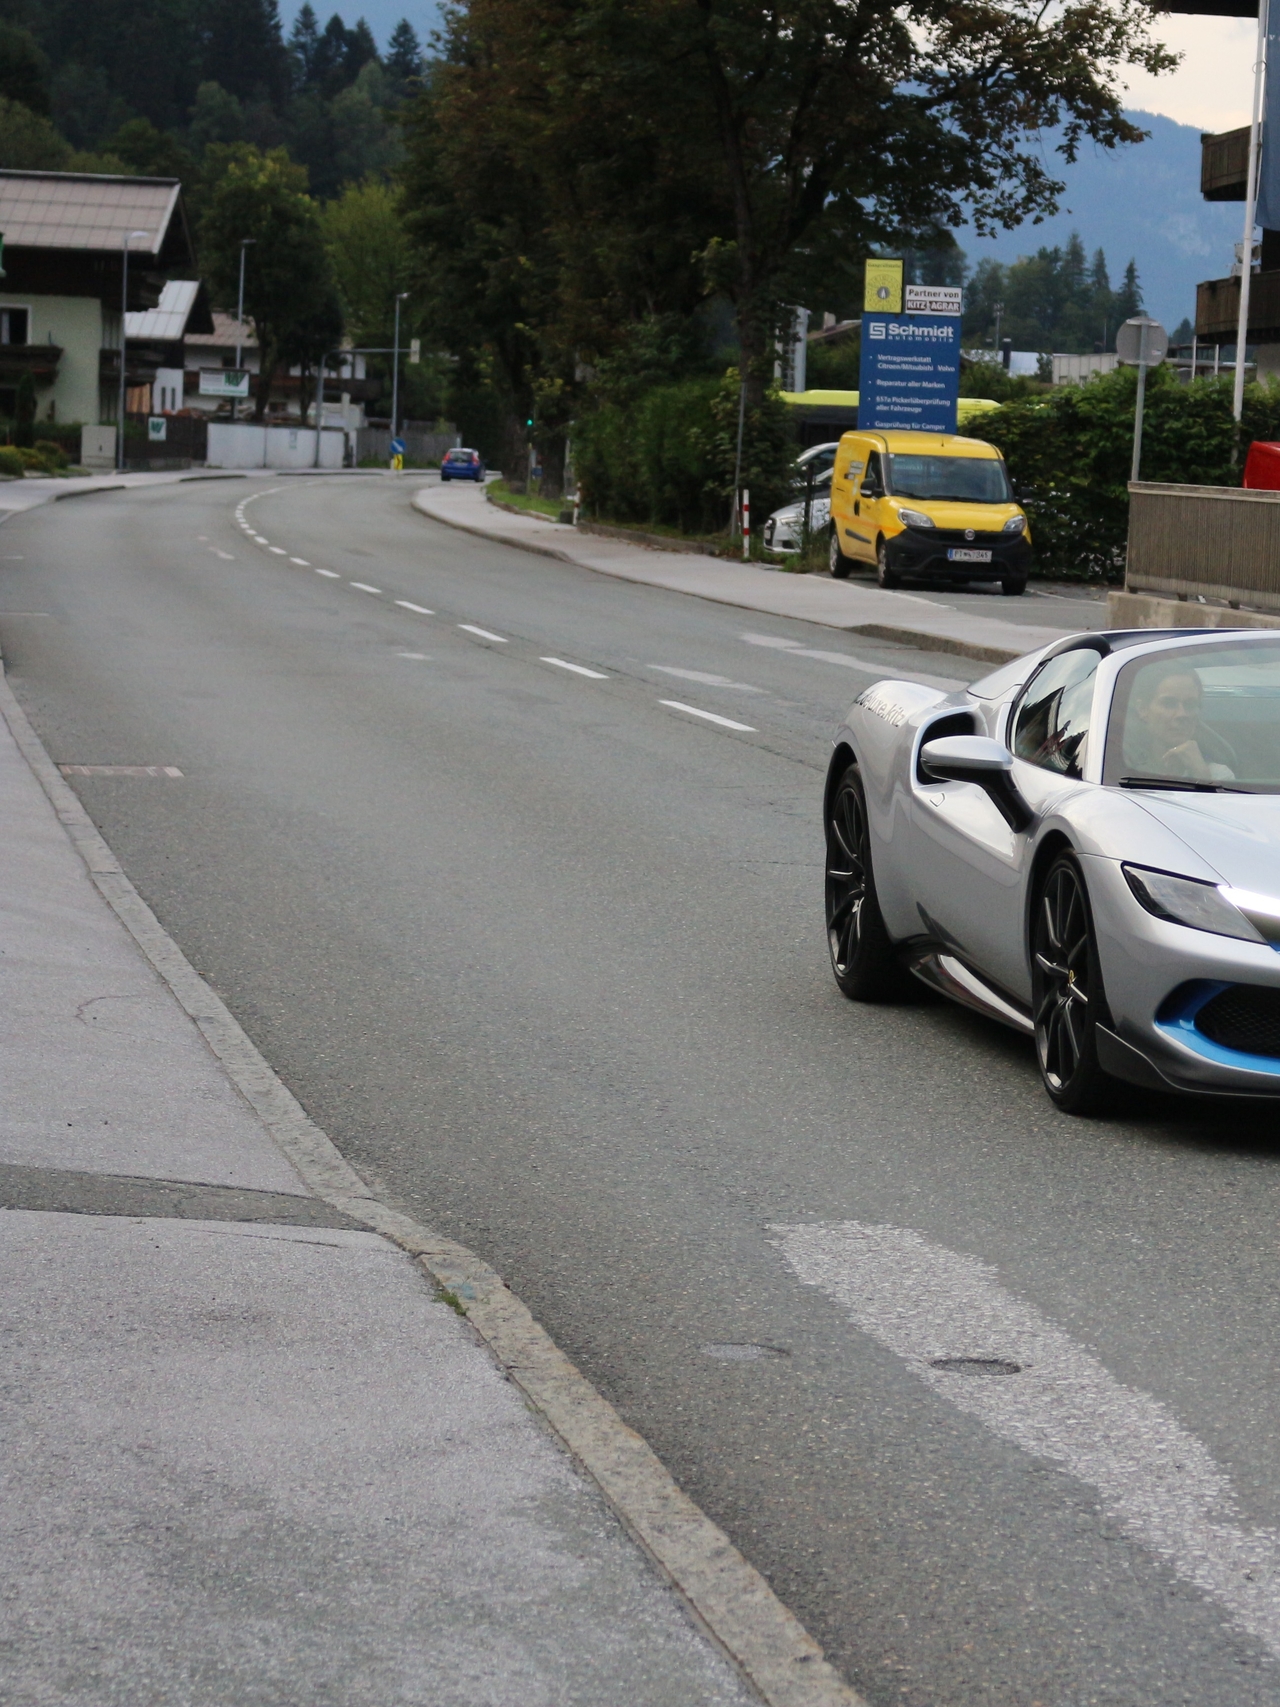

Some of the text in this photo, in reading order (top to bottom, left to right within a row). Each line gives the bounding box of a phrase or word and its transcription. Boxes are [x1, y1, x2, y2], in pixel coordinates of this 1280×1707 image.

[909, 289, 959, 298] Partner von
[907, 300, 959, 311] KITZ AGRAR
[888, 323, 954, 337] Schmidt
